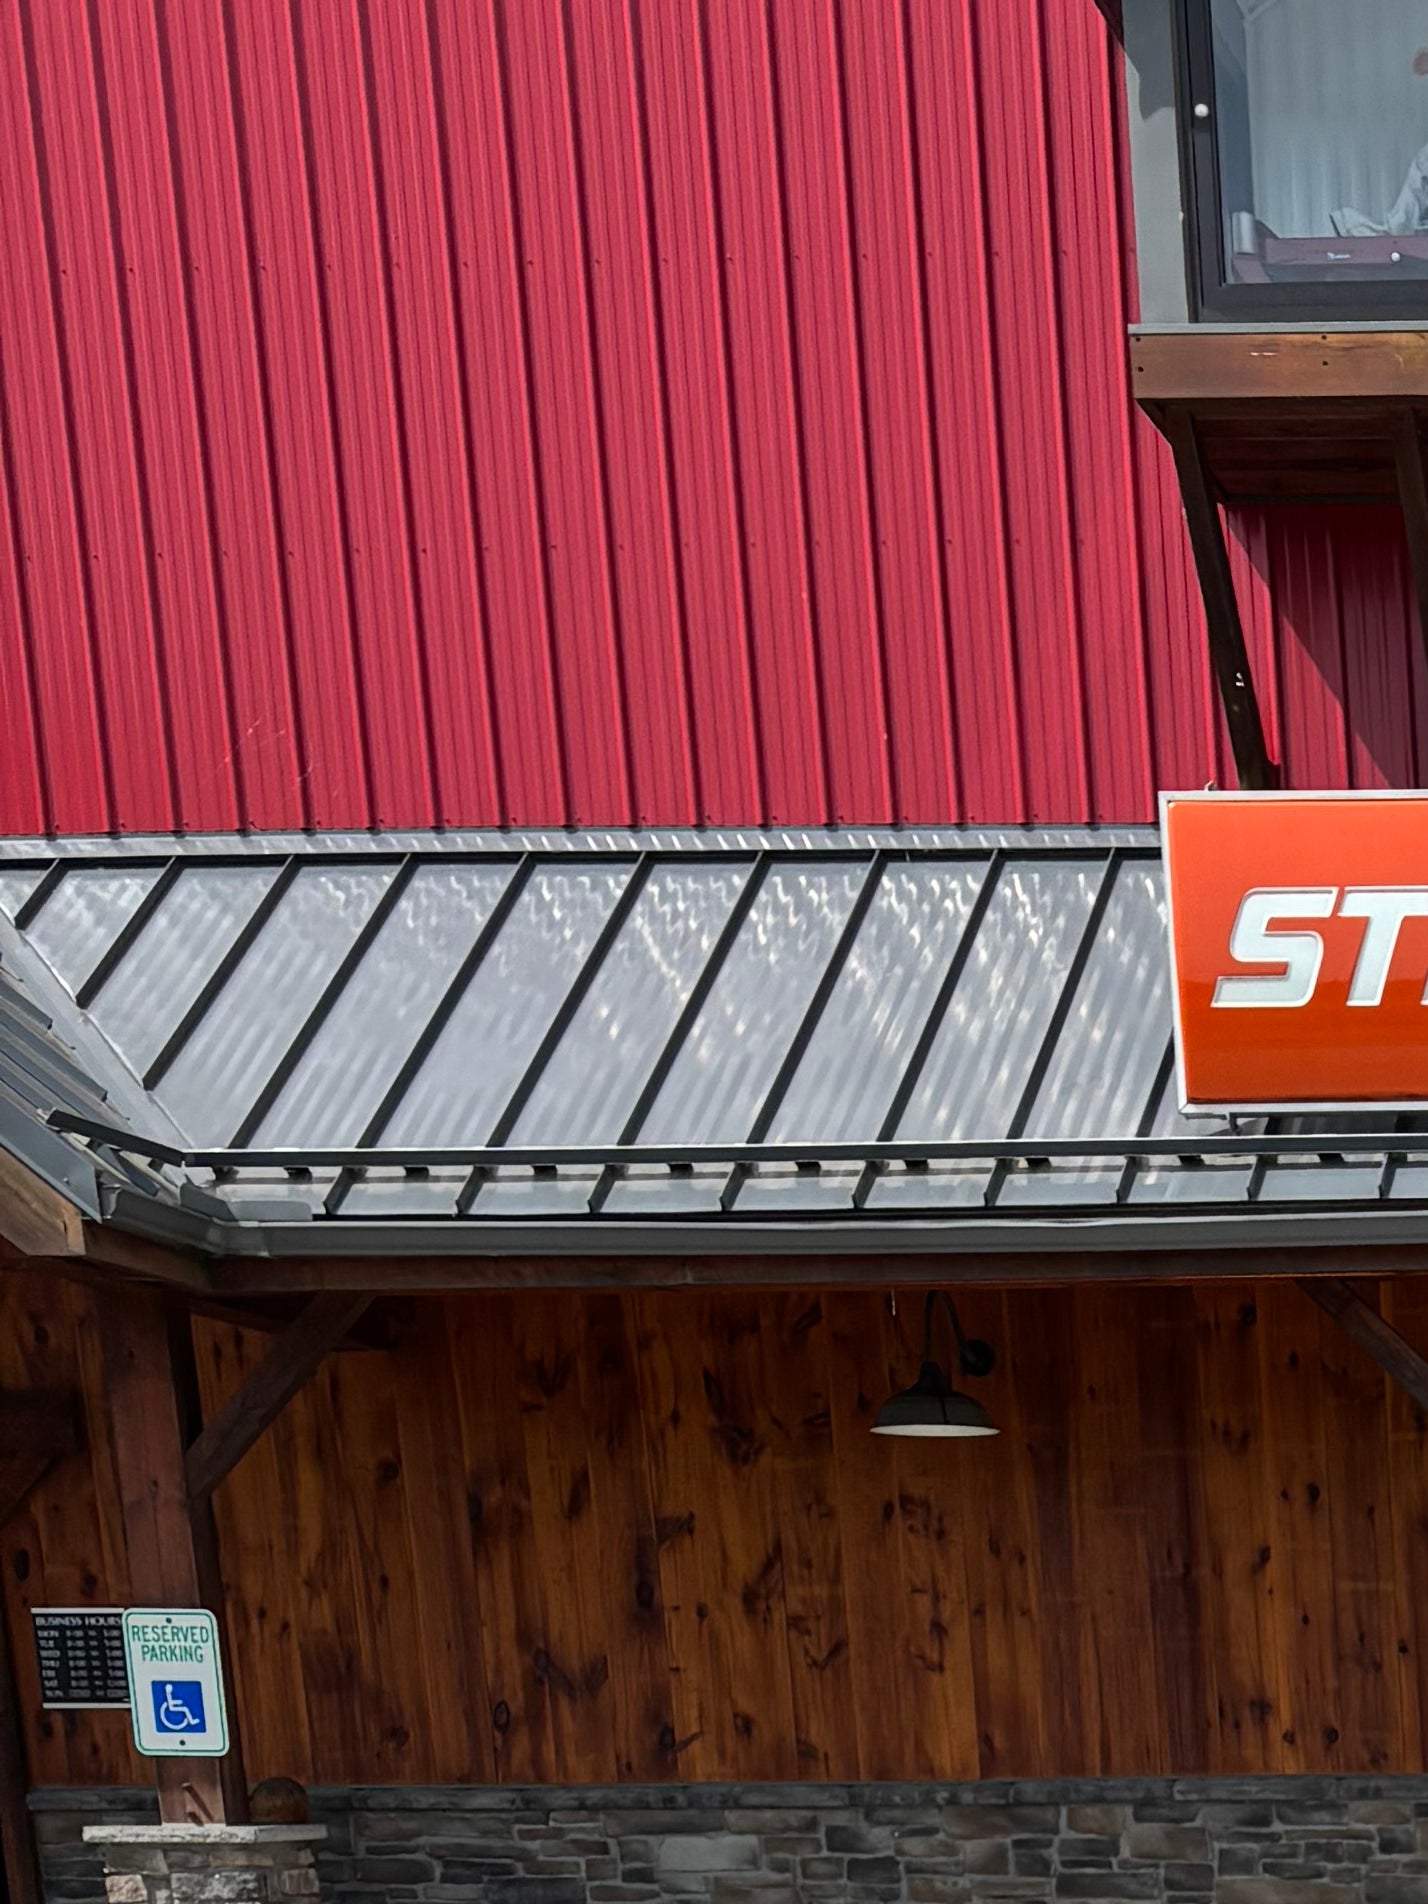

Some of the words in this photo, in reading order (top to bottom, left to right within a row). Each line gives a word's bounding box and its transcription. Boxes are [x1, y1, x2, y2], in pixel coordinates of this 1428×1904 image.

[35, 1616, 82, 1626] BUSINESS
[131, 1625, 210, 1643] RESERVED
[142, 1645, 204, 1663] PARKING
